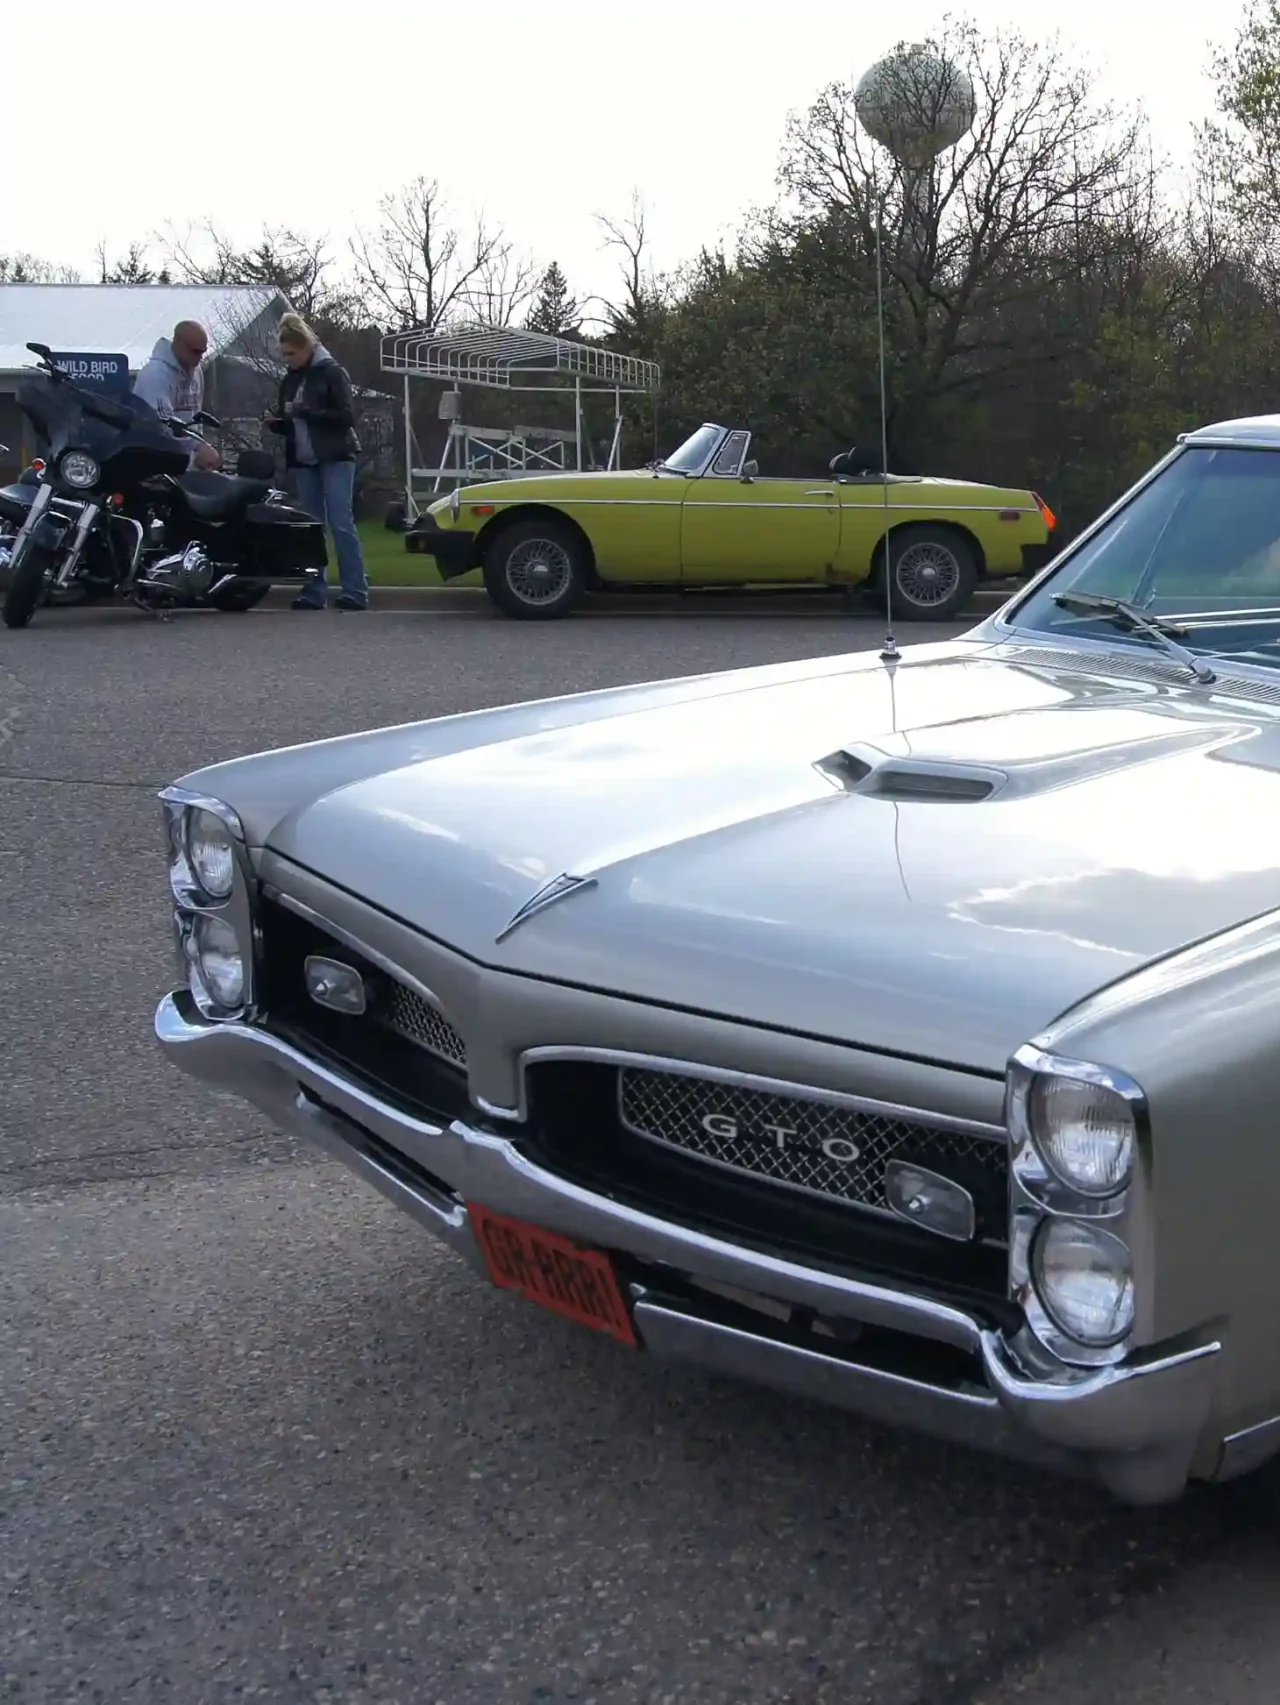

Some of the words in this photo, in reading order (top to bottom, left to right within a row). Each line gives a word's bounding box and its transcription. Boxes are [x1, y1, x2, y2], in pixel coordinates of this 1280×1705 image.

[57, 360, 88, 373] WILD
[91, 361, 118, 374] BIRD
[702, 1114, 860, 1161] GTO
